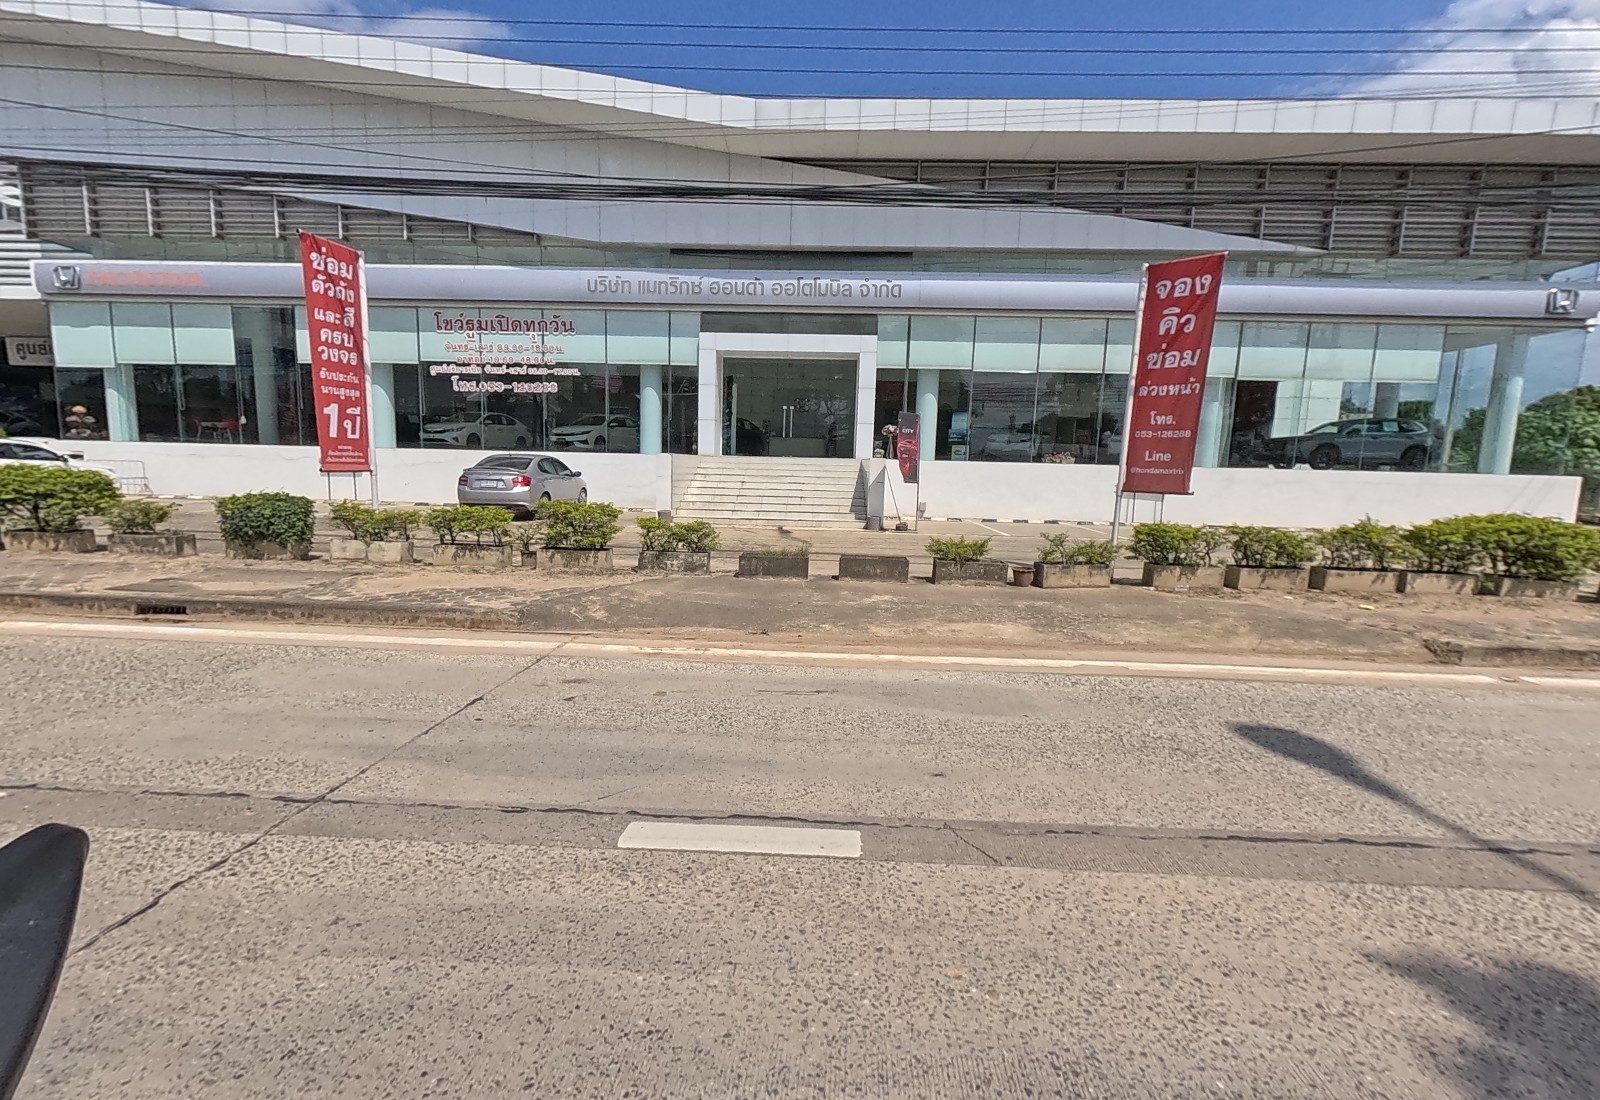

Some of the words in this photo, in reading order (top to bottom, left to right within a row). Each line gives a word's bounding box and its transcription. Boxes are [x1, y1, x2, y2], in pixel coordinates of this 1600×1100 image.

[310, 246, 353, 280] ซ่อม
[311, 274, 355, 303] ตัวถัง
[587, 275, 632, 294] บริษัท
[709, 277, 765, 296] ฮอนด้า
[859, 278, 902, 298] จำกัด
[1155, 274, 1212, 299] จอง
[434, 311, 576, 342] โชว์รูมเปิดทุกวัน
[1158, 306, 1197, 335] คิว
[320, 328, 354, 348] ครบ
[317, 345, 358, 365] วงจร
[1147, 343, 1201, 369] ซ่อม
[320, 367, 360, 384] รับประกัน
[1139, 377, 1200, 397] ล่วงหน้า
[323, 403, 339, 438] 1
[343, 406, 361, 439] ปี
[1149, 411, 1176, 425] โทร.
[1145, 451, 1172, 462] Line
